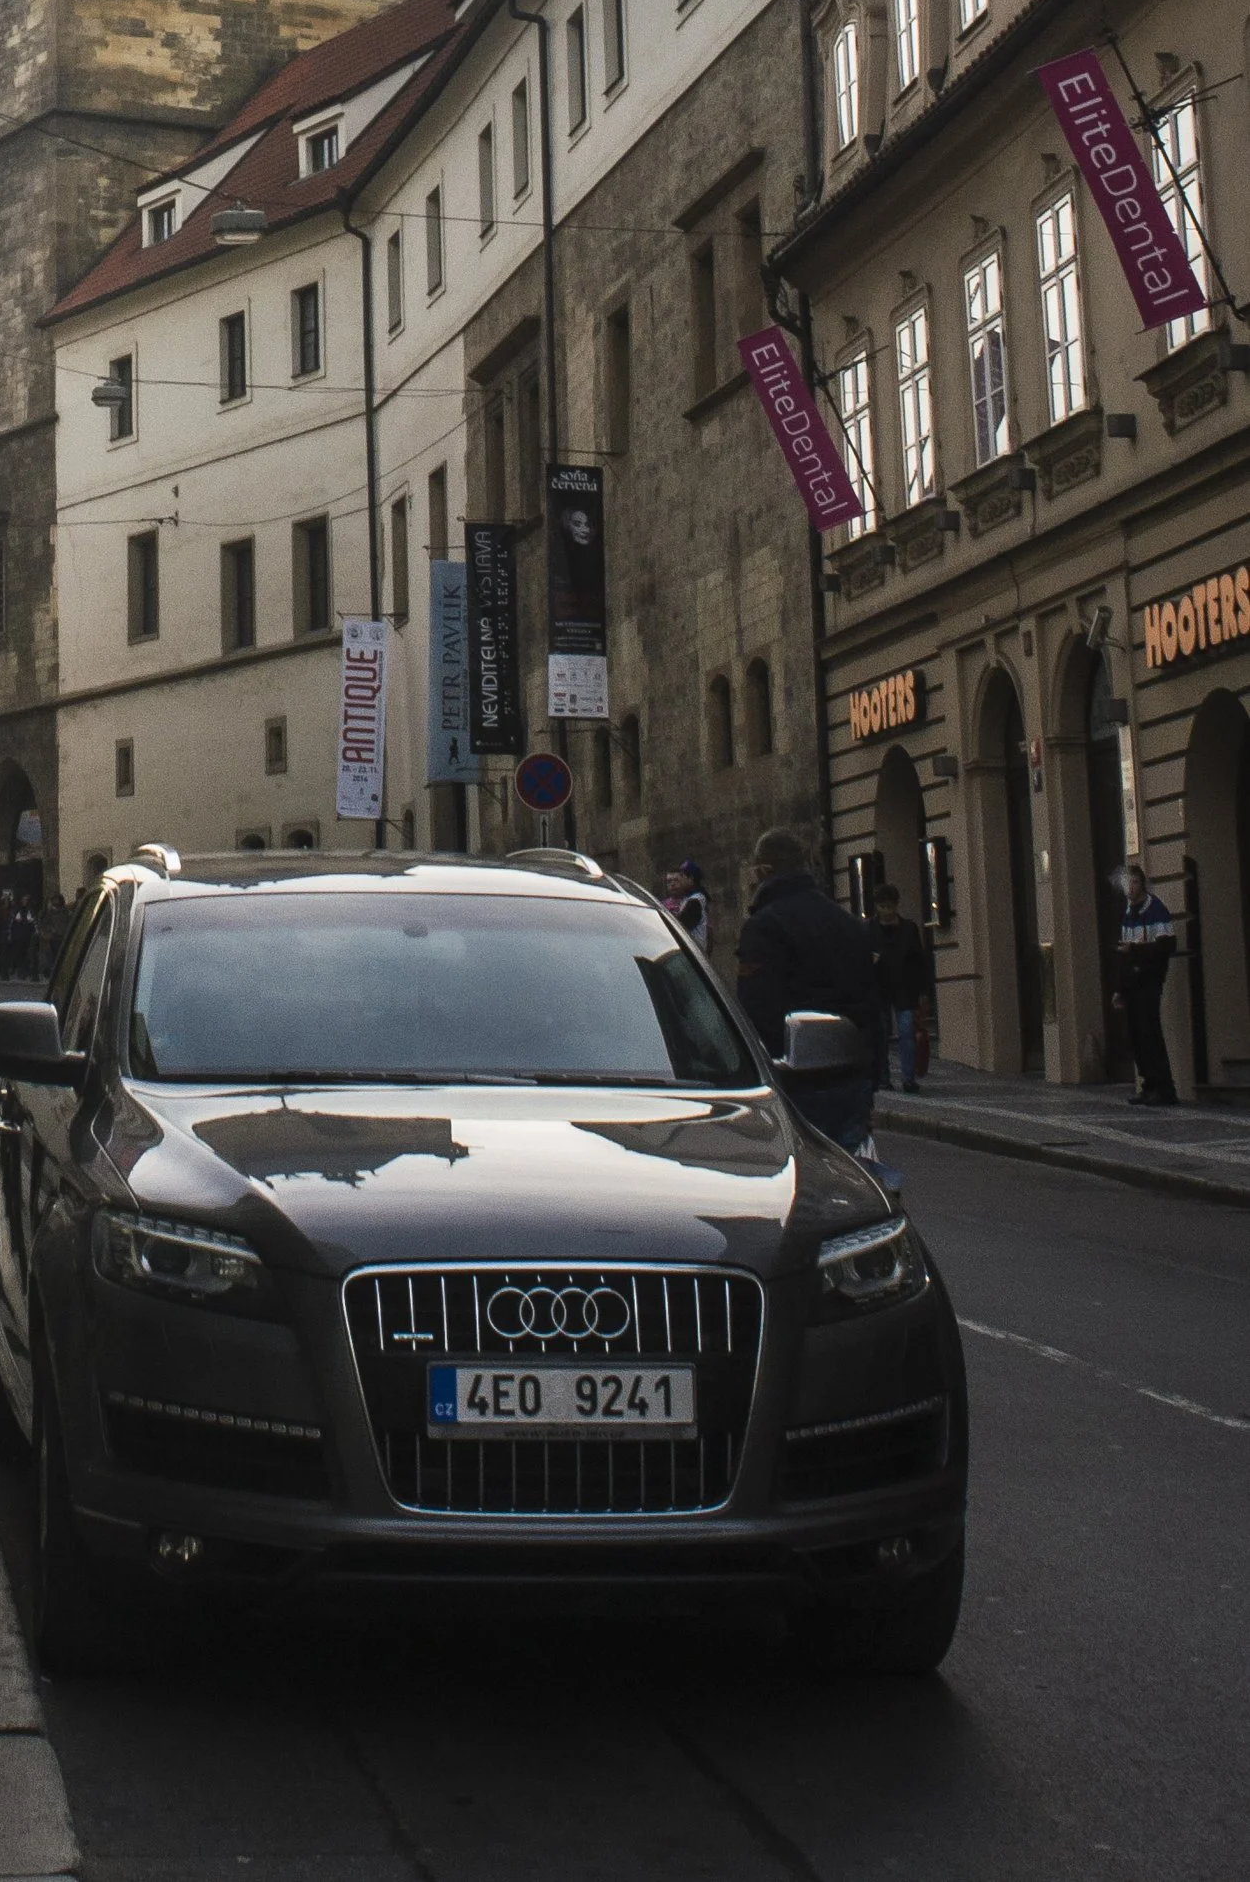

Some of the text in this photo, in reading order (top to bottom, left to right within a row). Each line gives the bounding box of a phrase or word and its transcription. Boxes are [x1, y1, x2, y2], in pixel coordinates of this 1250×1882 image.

[1057, 71, 1189, 307] EliteDental
[750, 341, 848, 518] EliteDental
[439, 584, 461, 731] PETR PAVLÍK
[477, 617, 499, 729] NEVIDITELNÁ
[1144, 565, 1250, 670] HOOTERS
[341, 647, 382, 764] ANTIQUE
[850, 668, 917, 742] HOOTERS
[434, 1402, 454, 1417] CZ
[466, 1374, 672, 1418] 4E0 9241
